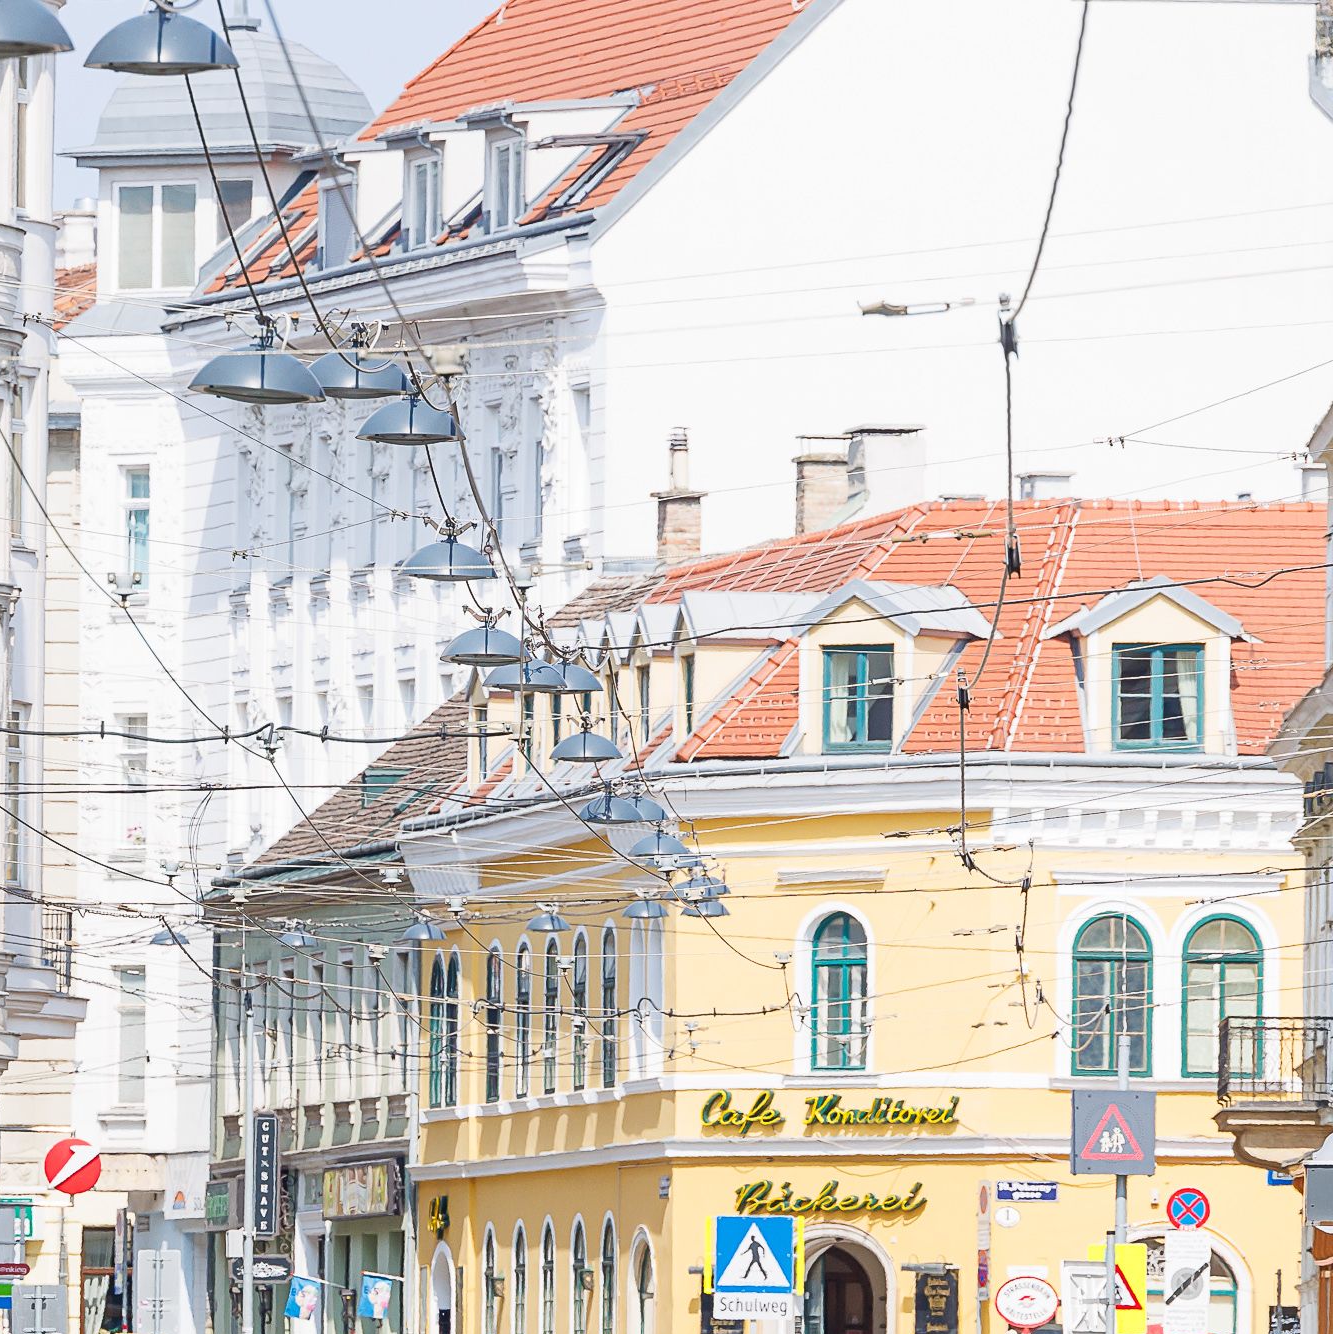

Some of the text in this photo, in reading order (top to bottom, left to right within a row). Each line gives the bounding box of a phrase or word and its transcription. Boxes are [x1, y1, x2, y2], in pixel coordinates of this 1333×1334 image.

[700, 1088, 960, 1135] Cafe Konditorei
[259, 1121, 270, 1231] CUT SHAVE
[720, 1296, 788, 1317] Schulweg
